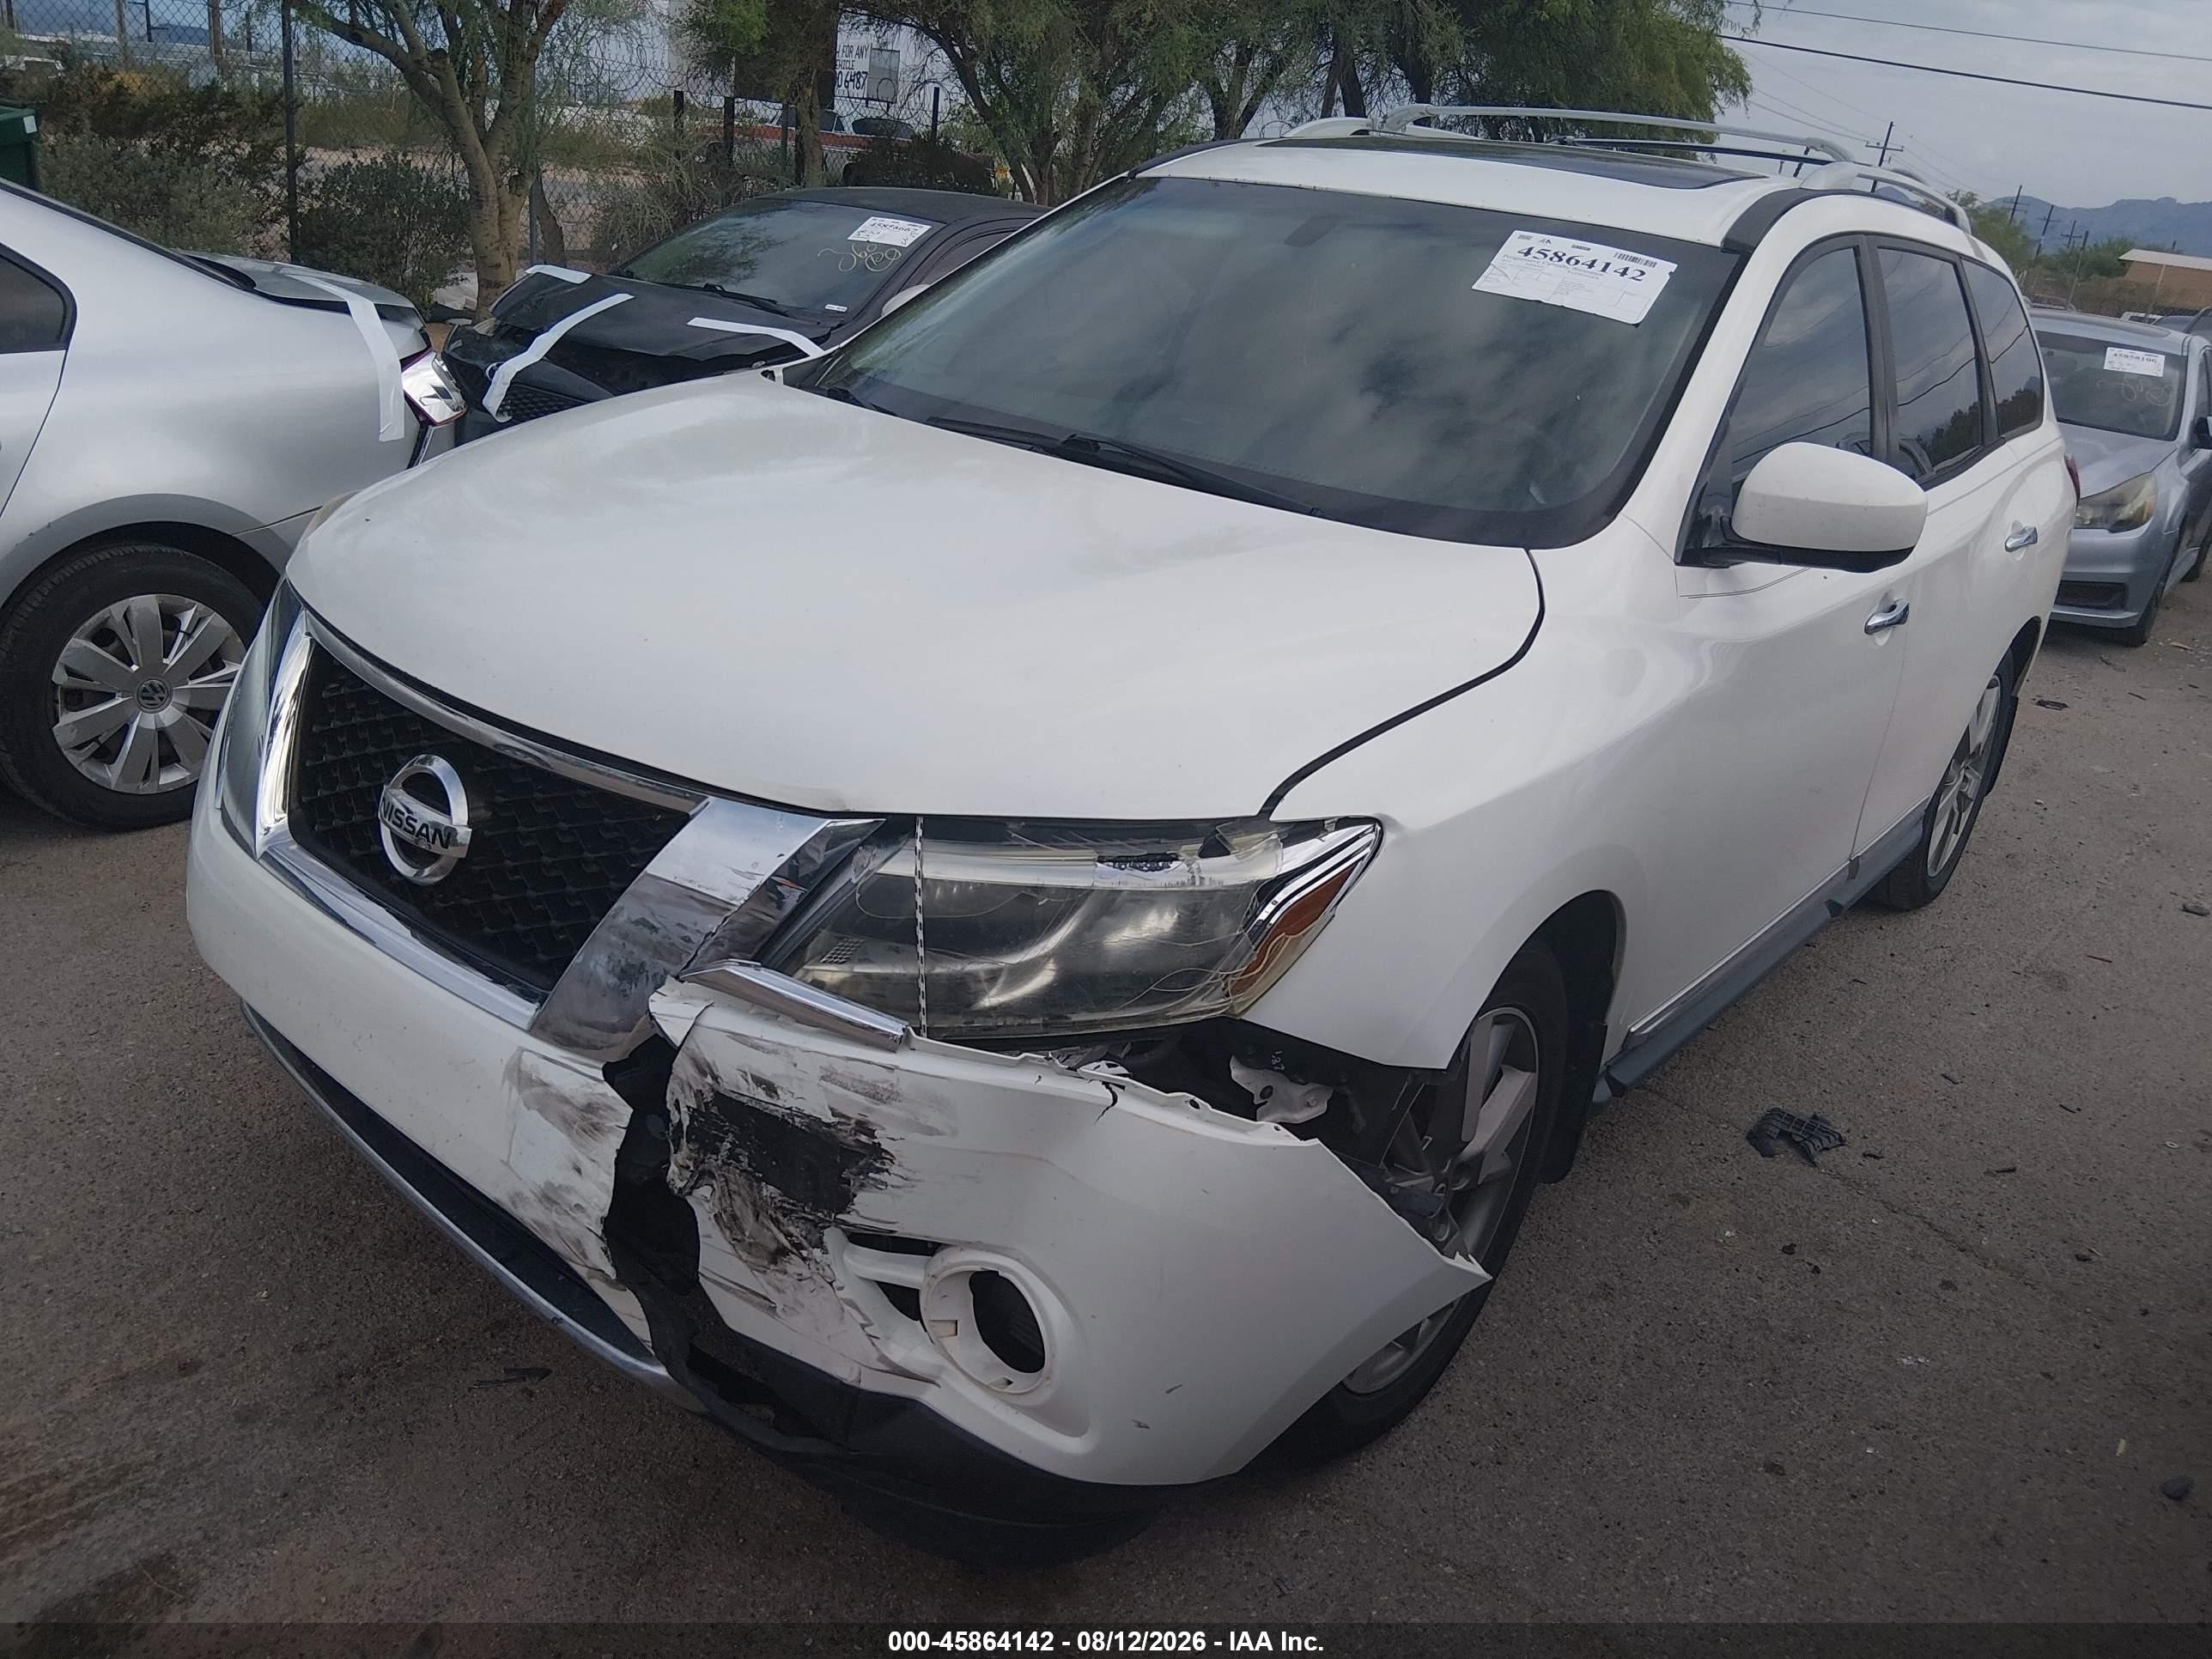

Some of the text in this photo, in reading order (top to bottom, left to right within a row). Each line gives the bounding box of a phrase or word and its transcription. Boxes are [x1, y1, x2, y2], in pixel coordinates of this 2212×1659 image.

[842, 45, 854, 58] FOR
[854, 45, 870, 59] ANY
[1517, 246, 1647, 283] 45864142
[380, 796, 452, 849] NISSAN
